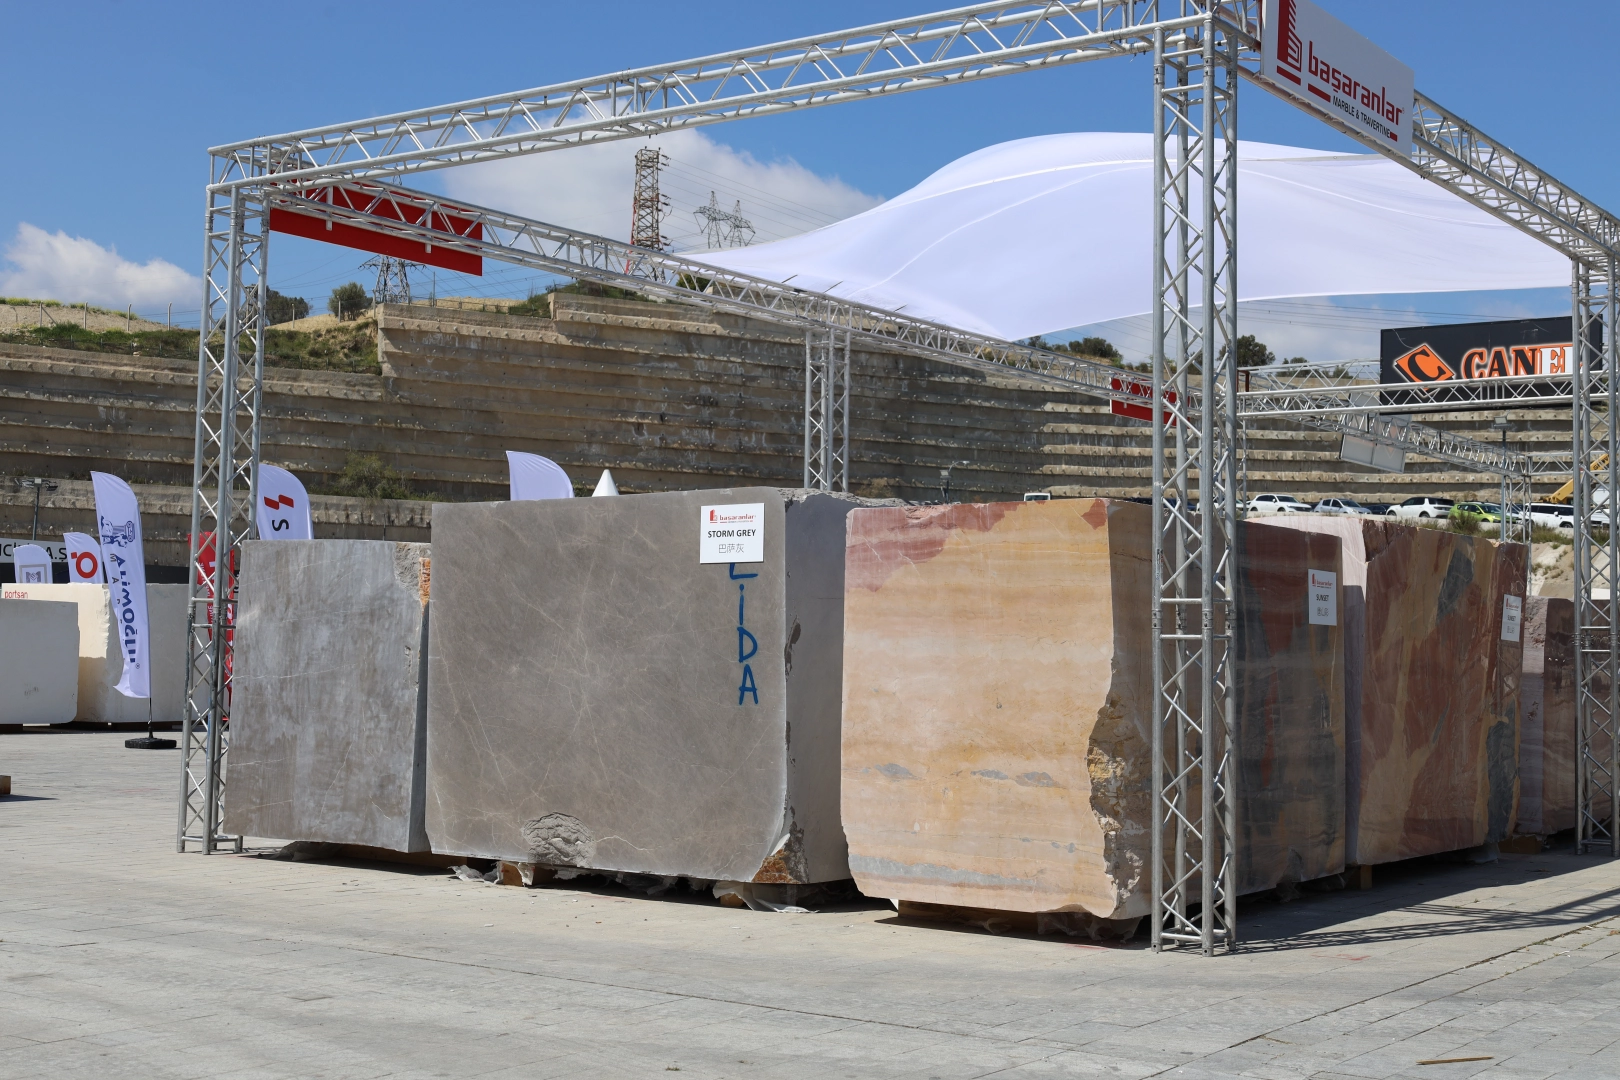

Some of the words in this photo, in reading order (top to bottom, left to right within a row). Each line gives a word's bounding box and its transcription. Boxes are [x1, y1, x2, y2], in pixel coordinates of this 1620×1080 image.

[1308, 40, 1403, 126] başaranlar
[1332, 95, 1355, 117] MARBLE
[1355, 109, 1360, 120] &
[1361, 111, 1391, 139] TRAVERTINE
[707, 529, 735, 539] STORM
[736, 528, 757, 538] GREY
